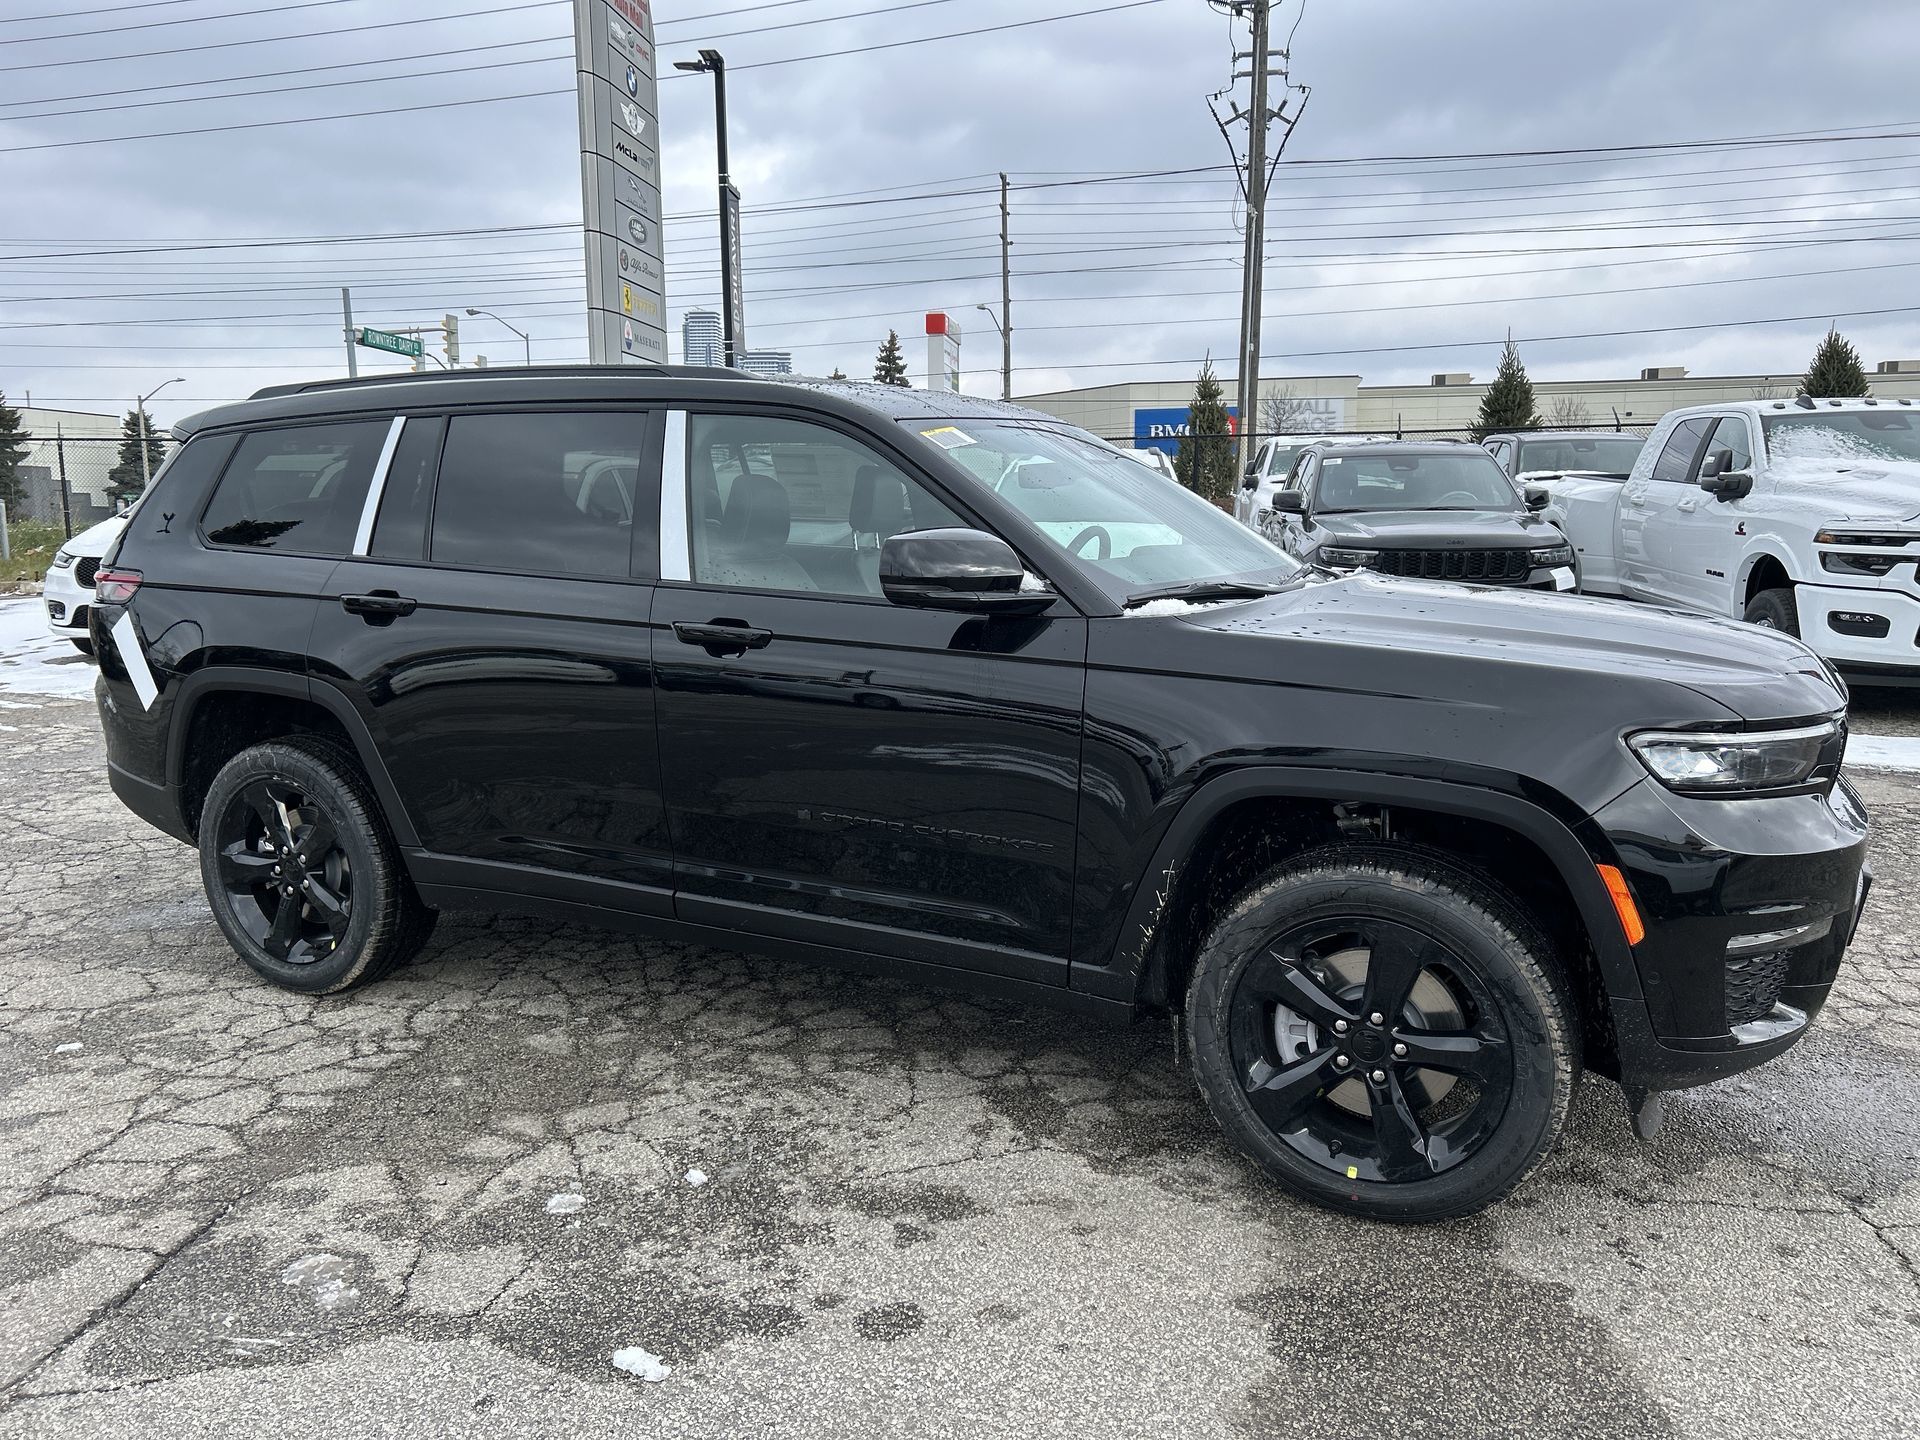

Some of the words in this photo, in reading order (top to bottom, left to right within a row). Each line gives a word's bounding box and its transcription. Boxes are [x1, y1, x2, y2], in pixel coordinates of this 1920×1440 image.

[730, 207, 740, 305] DILAWRI
[368, 330, 397, 349] ROWNTREE
[398, 338, 414, 353] DAIRY
[633, 333, 661, 351] MASERATI
[912, 824, 1055, 855] CHEROKEE
